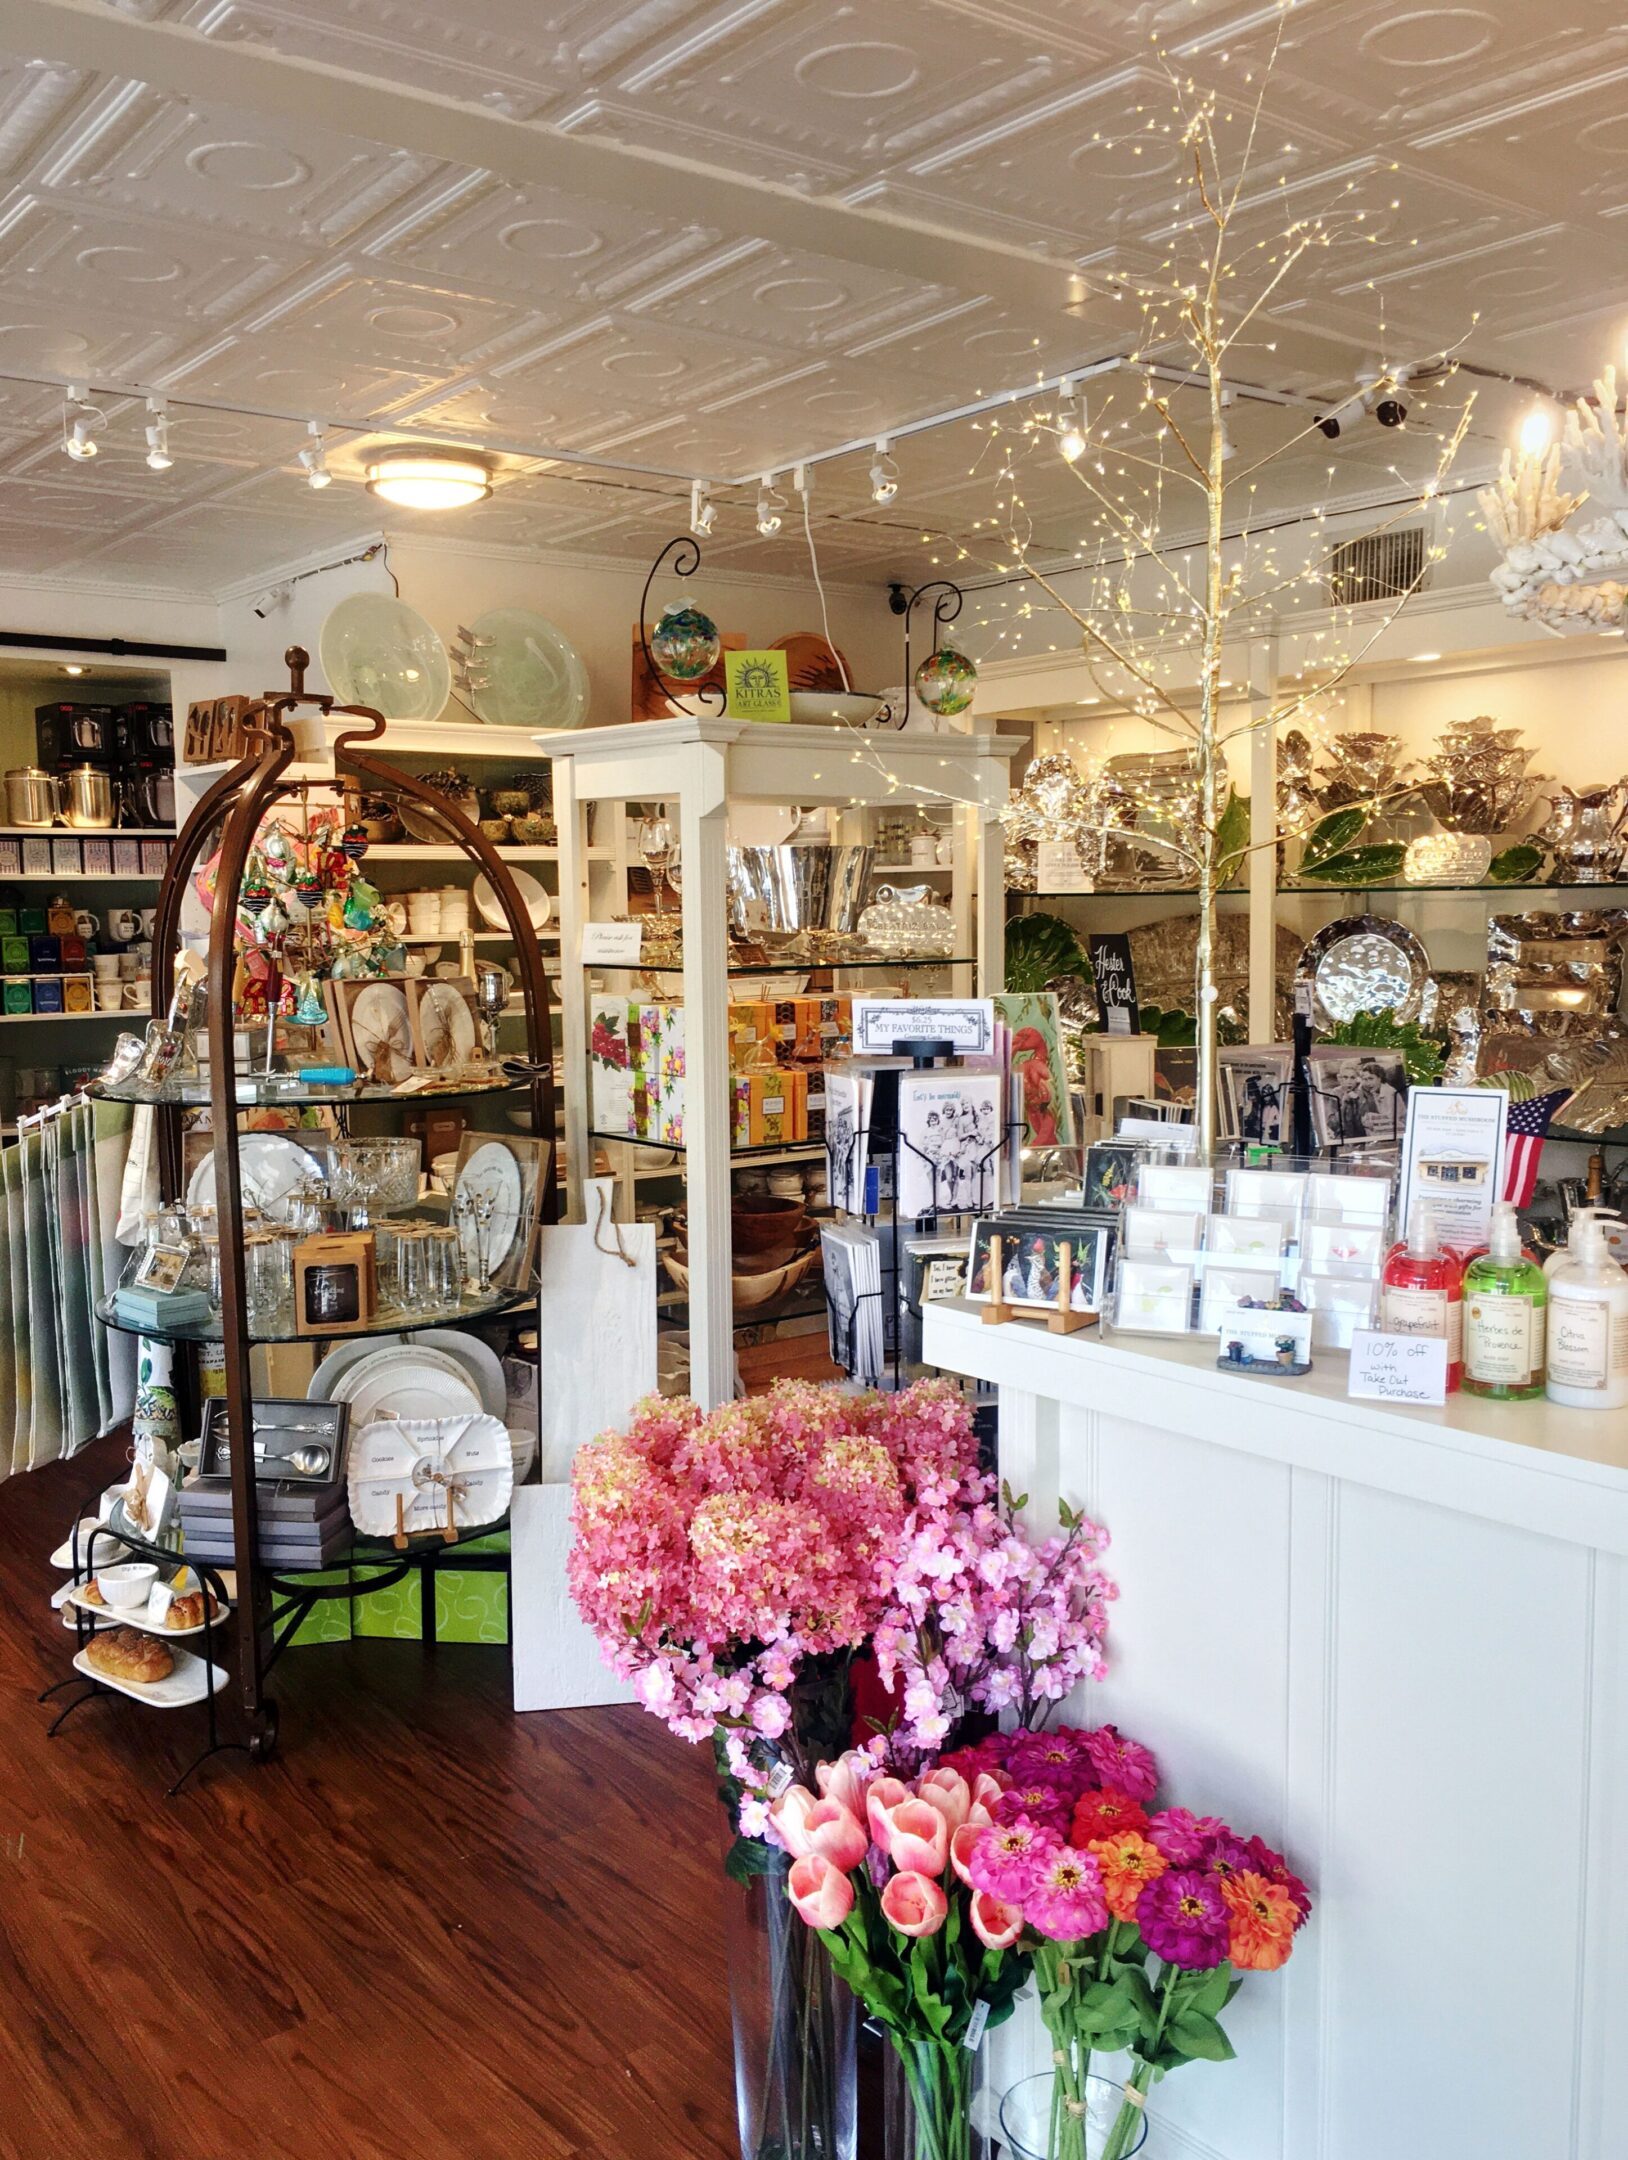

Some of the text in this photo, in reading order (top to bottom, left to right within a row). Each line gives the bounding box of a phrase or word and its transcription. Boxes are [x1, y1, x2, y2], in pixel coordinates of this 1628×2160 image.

[736, 689, 781, 699] KITRAS
[877, 921, 919, 931] BEATRIZ
[1094, 944, 1125, 980] Hester
[1107, 972, 1136, 1008] Cook
[911, 1016, 933, 1024] $6.25
[875, 1023, 973, 1034] MY FAVORITE THINGS
[929, 1092, 935, 1101] be
[1430, 1114, 1458, 1122] STUFFED
[1477, 1319, 1525, 1336] Herbes de
[1478, 1335, 1523, 1350] Provence
[1366, 1342, 1430, 1358] 10% off
[1371, 1362, 1397, 1373] with
[1360, 1371, 1409, 1386] Take Out
[1379, 1385, 1431, 1399] Purchase
[464, 1479, 484, 1487] Candy
[371, 1488, 391, 1497] Candy
[430, 1503, 447, 1512] candy
